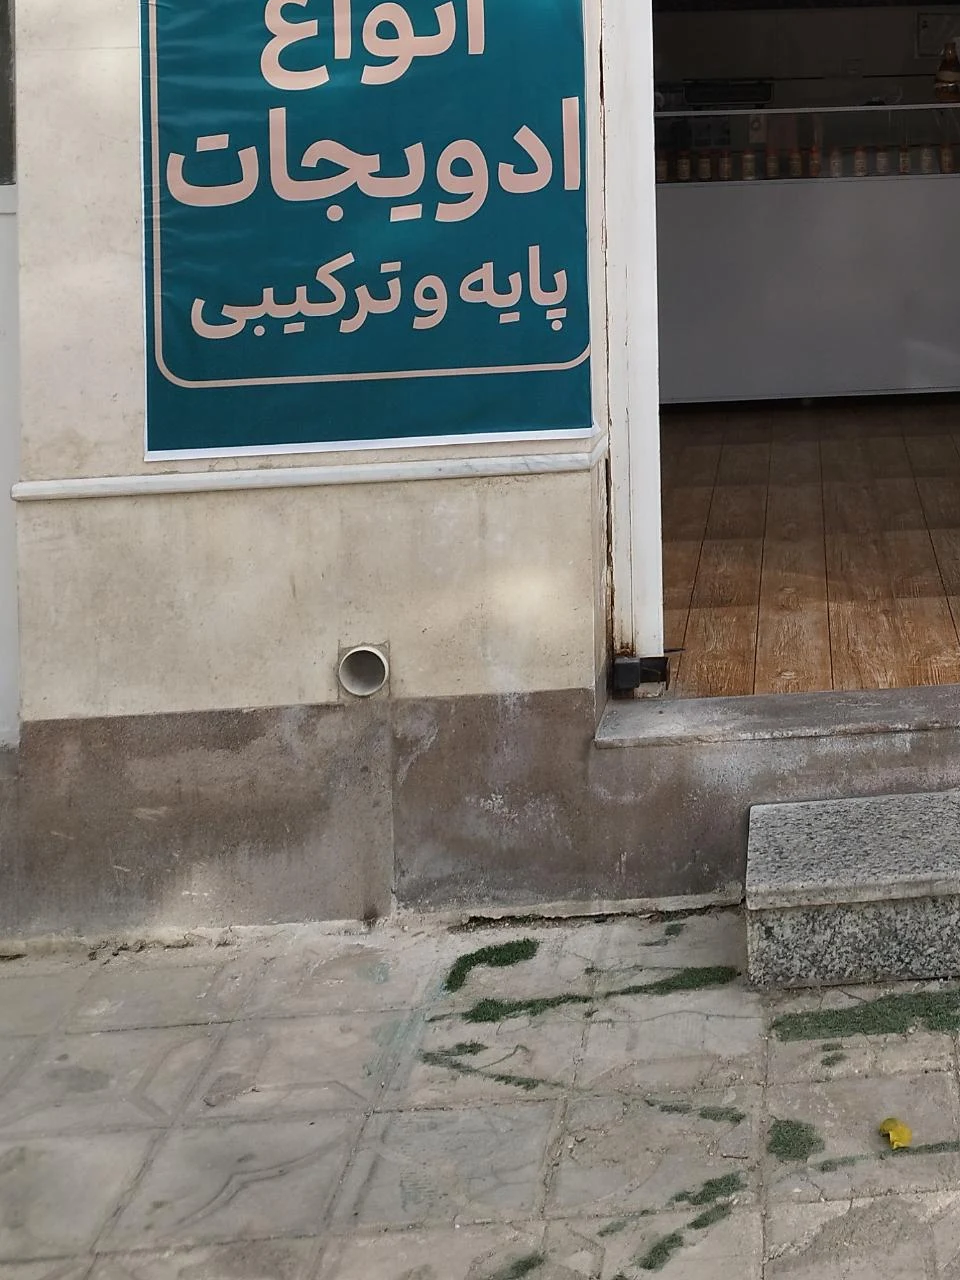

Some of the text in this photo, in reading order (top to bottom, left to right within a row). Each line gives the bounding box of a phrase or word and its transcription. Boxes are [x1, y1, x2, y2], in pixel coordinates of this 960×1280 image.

[165, 95, 582, 223] ادویجات
[190, 245, 570, 340] پایه و ترکیبی
